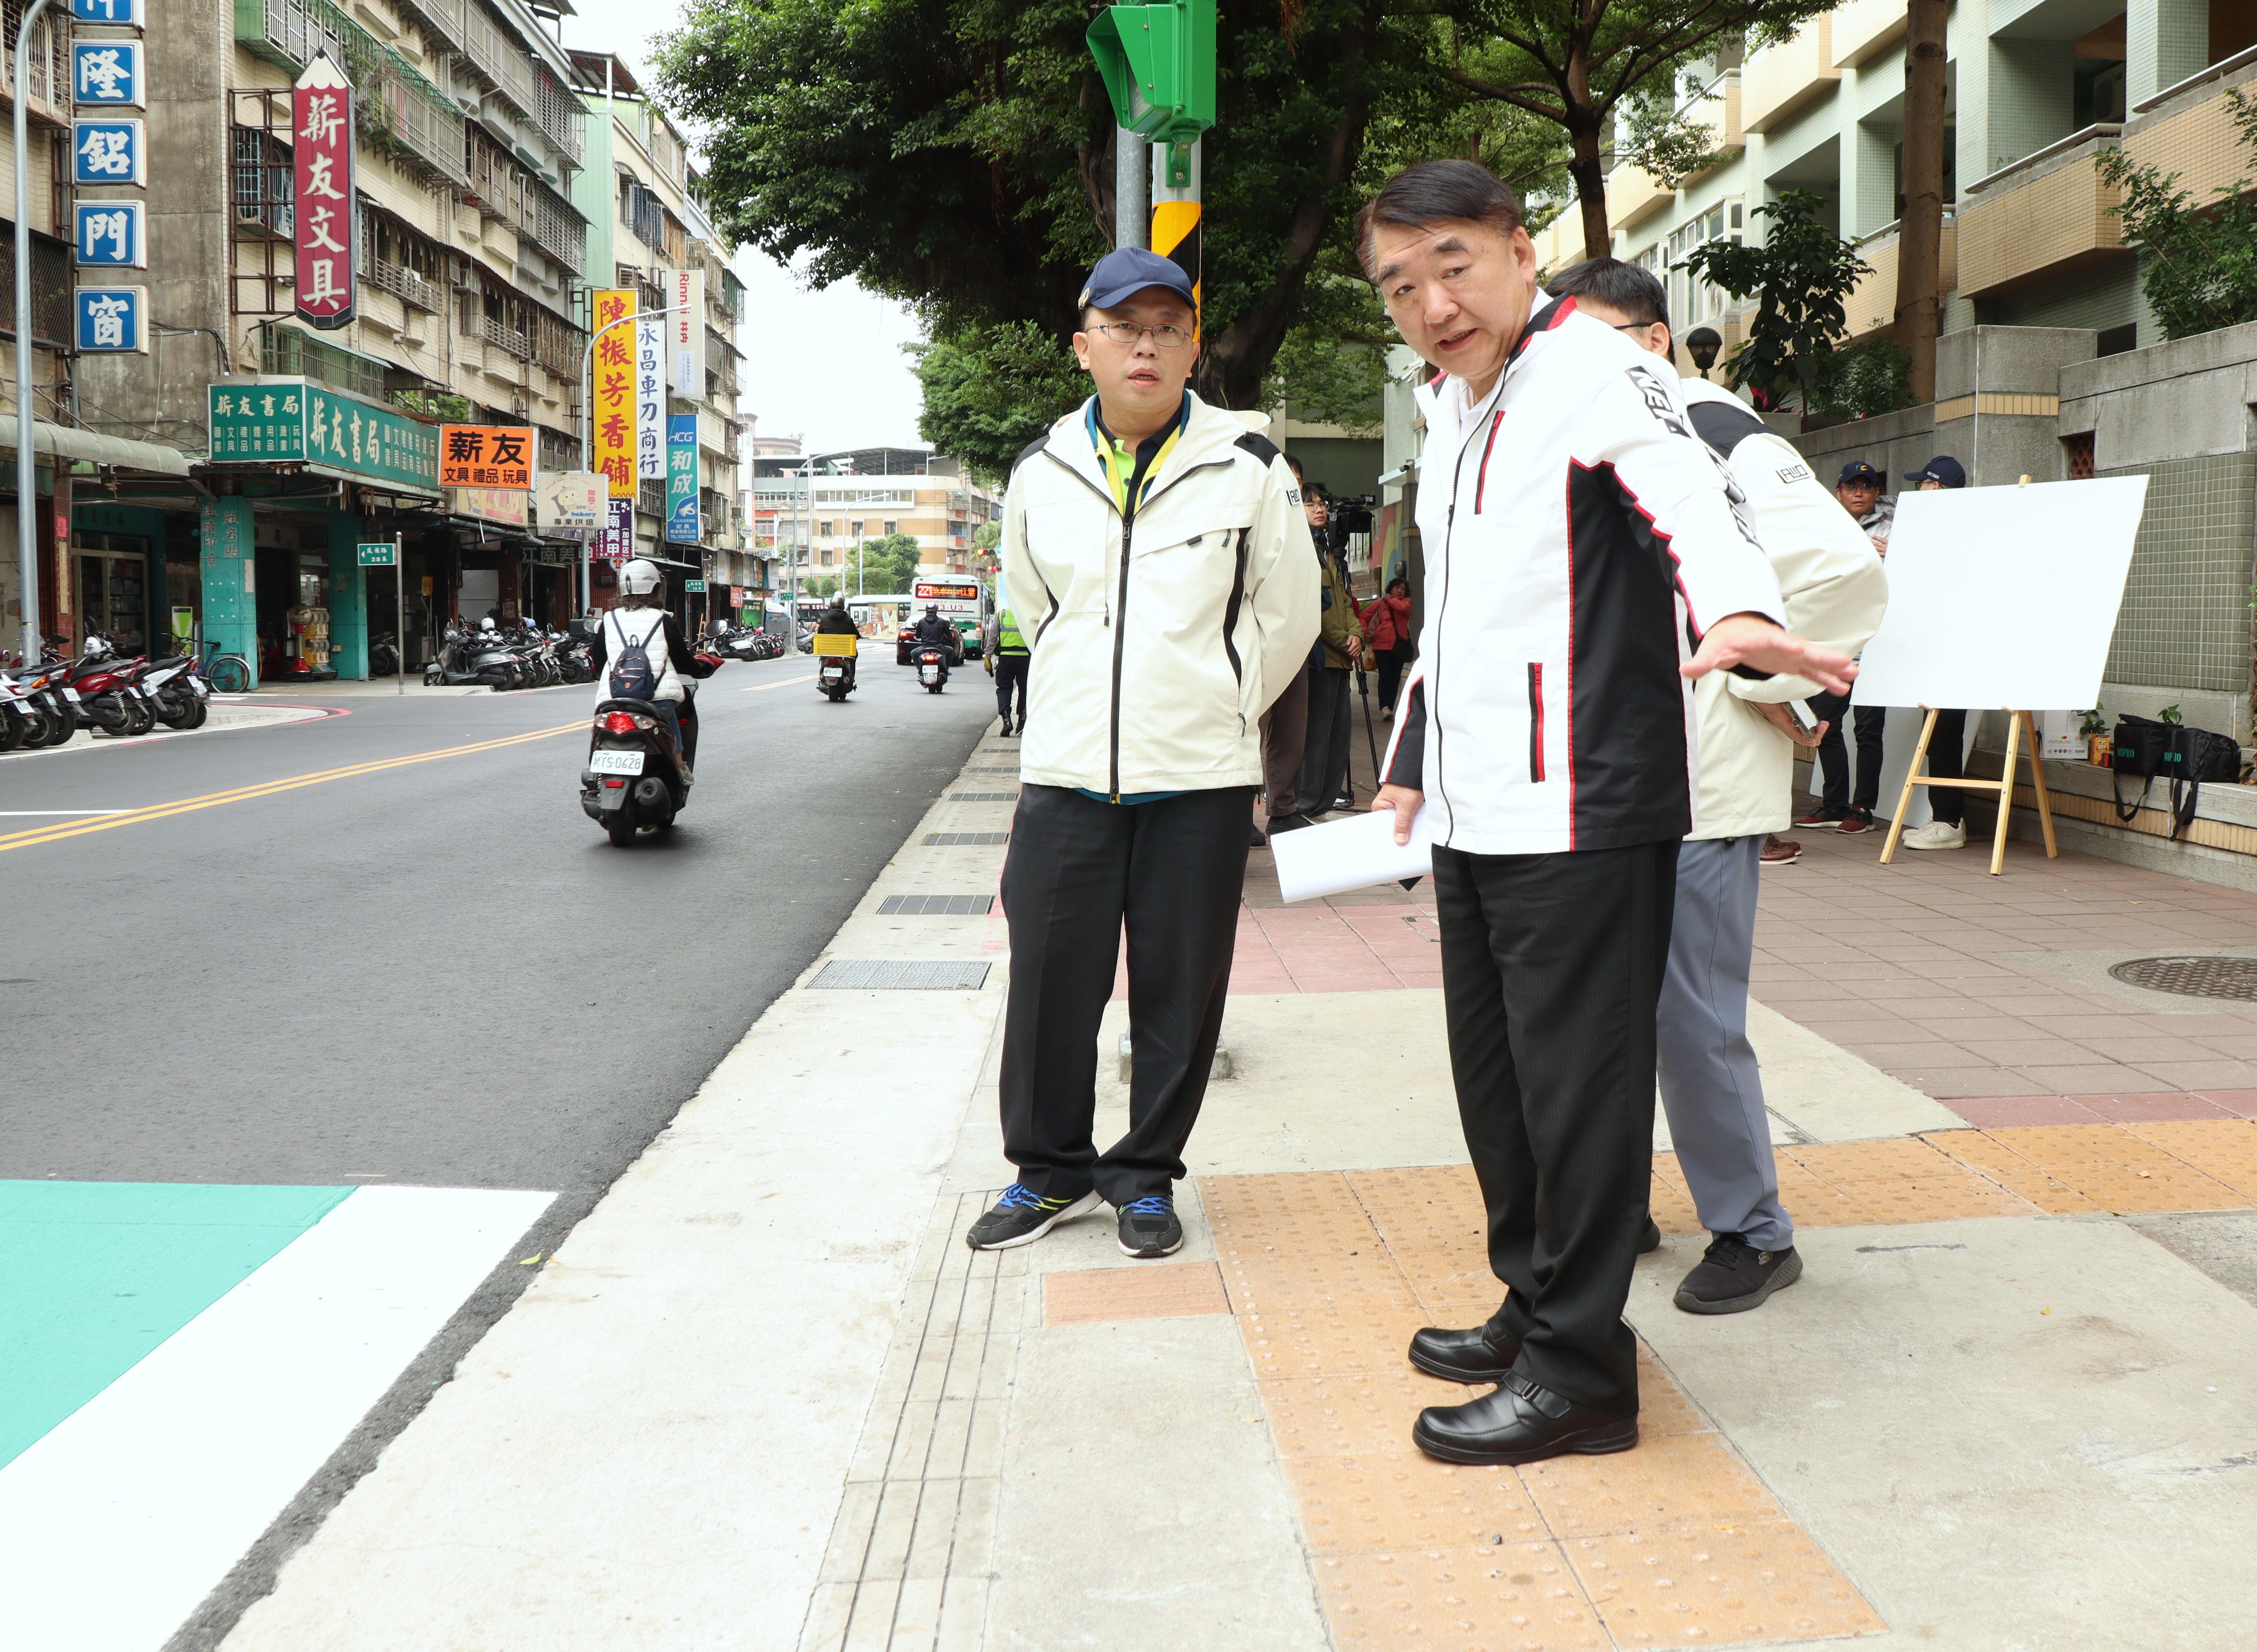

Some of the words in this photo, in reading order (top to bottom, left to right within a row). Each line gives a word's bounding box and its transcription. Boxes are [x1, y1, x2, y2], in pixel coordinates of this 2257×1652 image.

[299, 94, 346, 310] 薪友文具
[214, 394, 299, 418] 薪友書局
[638, 323, 659, 475] 永昌車刀商行
[227, 426, 235, 452] 文具
[293, 425, 301, 450] 玩具
[310, 397, 379, 465] 薪友書局
[449, 431, 526, 465] 薪友
[444, 467, 469, 482] 文具
[473, 468, 498, 484] 禮品
[503, 470, 528, 484] 玩具
[671, 450, 693, 494] 和成
[202, 503, 218, 568] 連續印章
[222, 511, 239, 557] 姓名貼
[606, 501, 620, 556] 江南美甲
[2117, 747, 2135, 759] MIPRO
[2164, 752, 2182, 762] MIPRO
